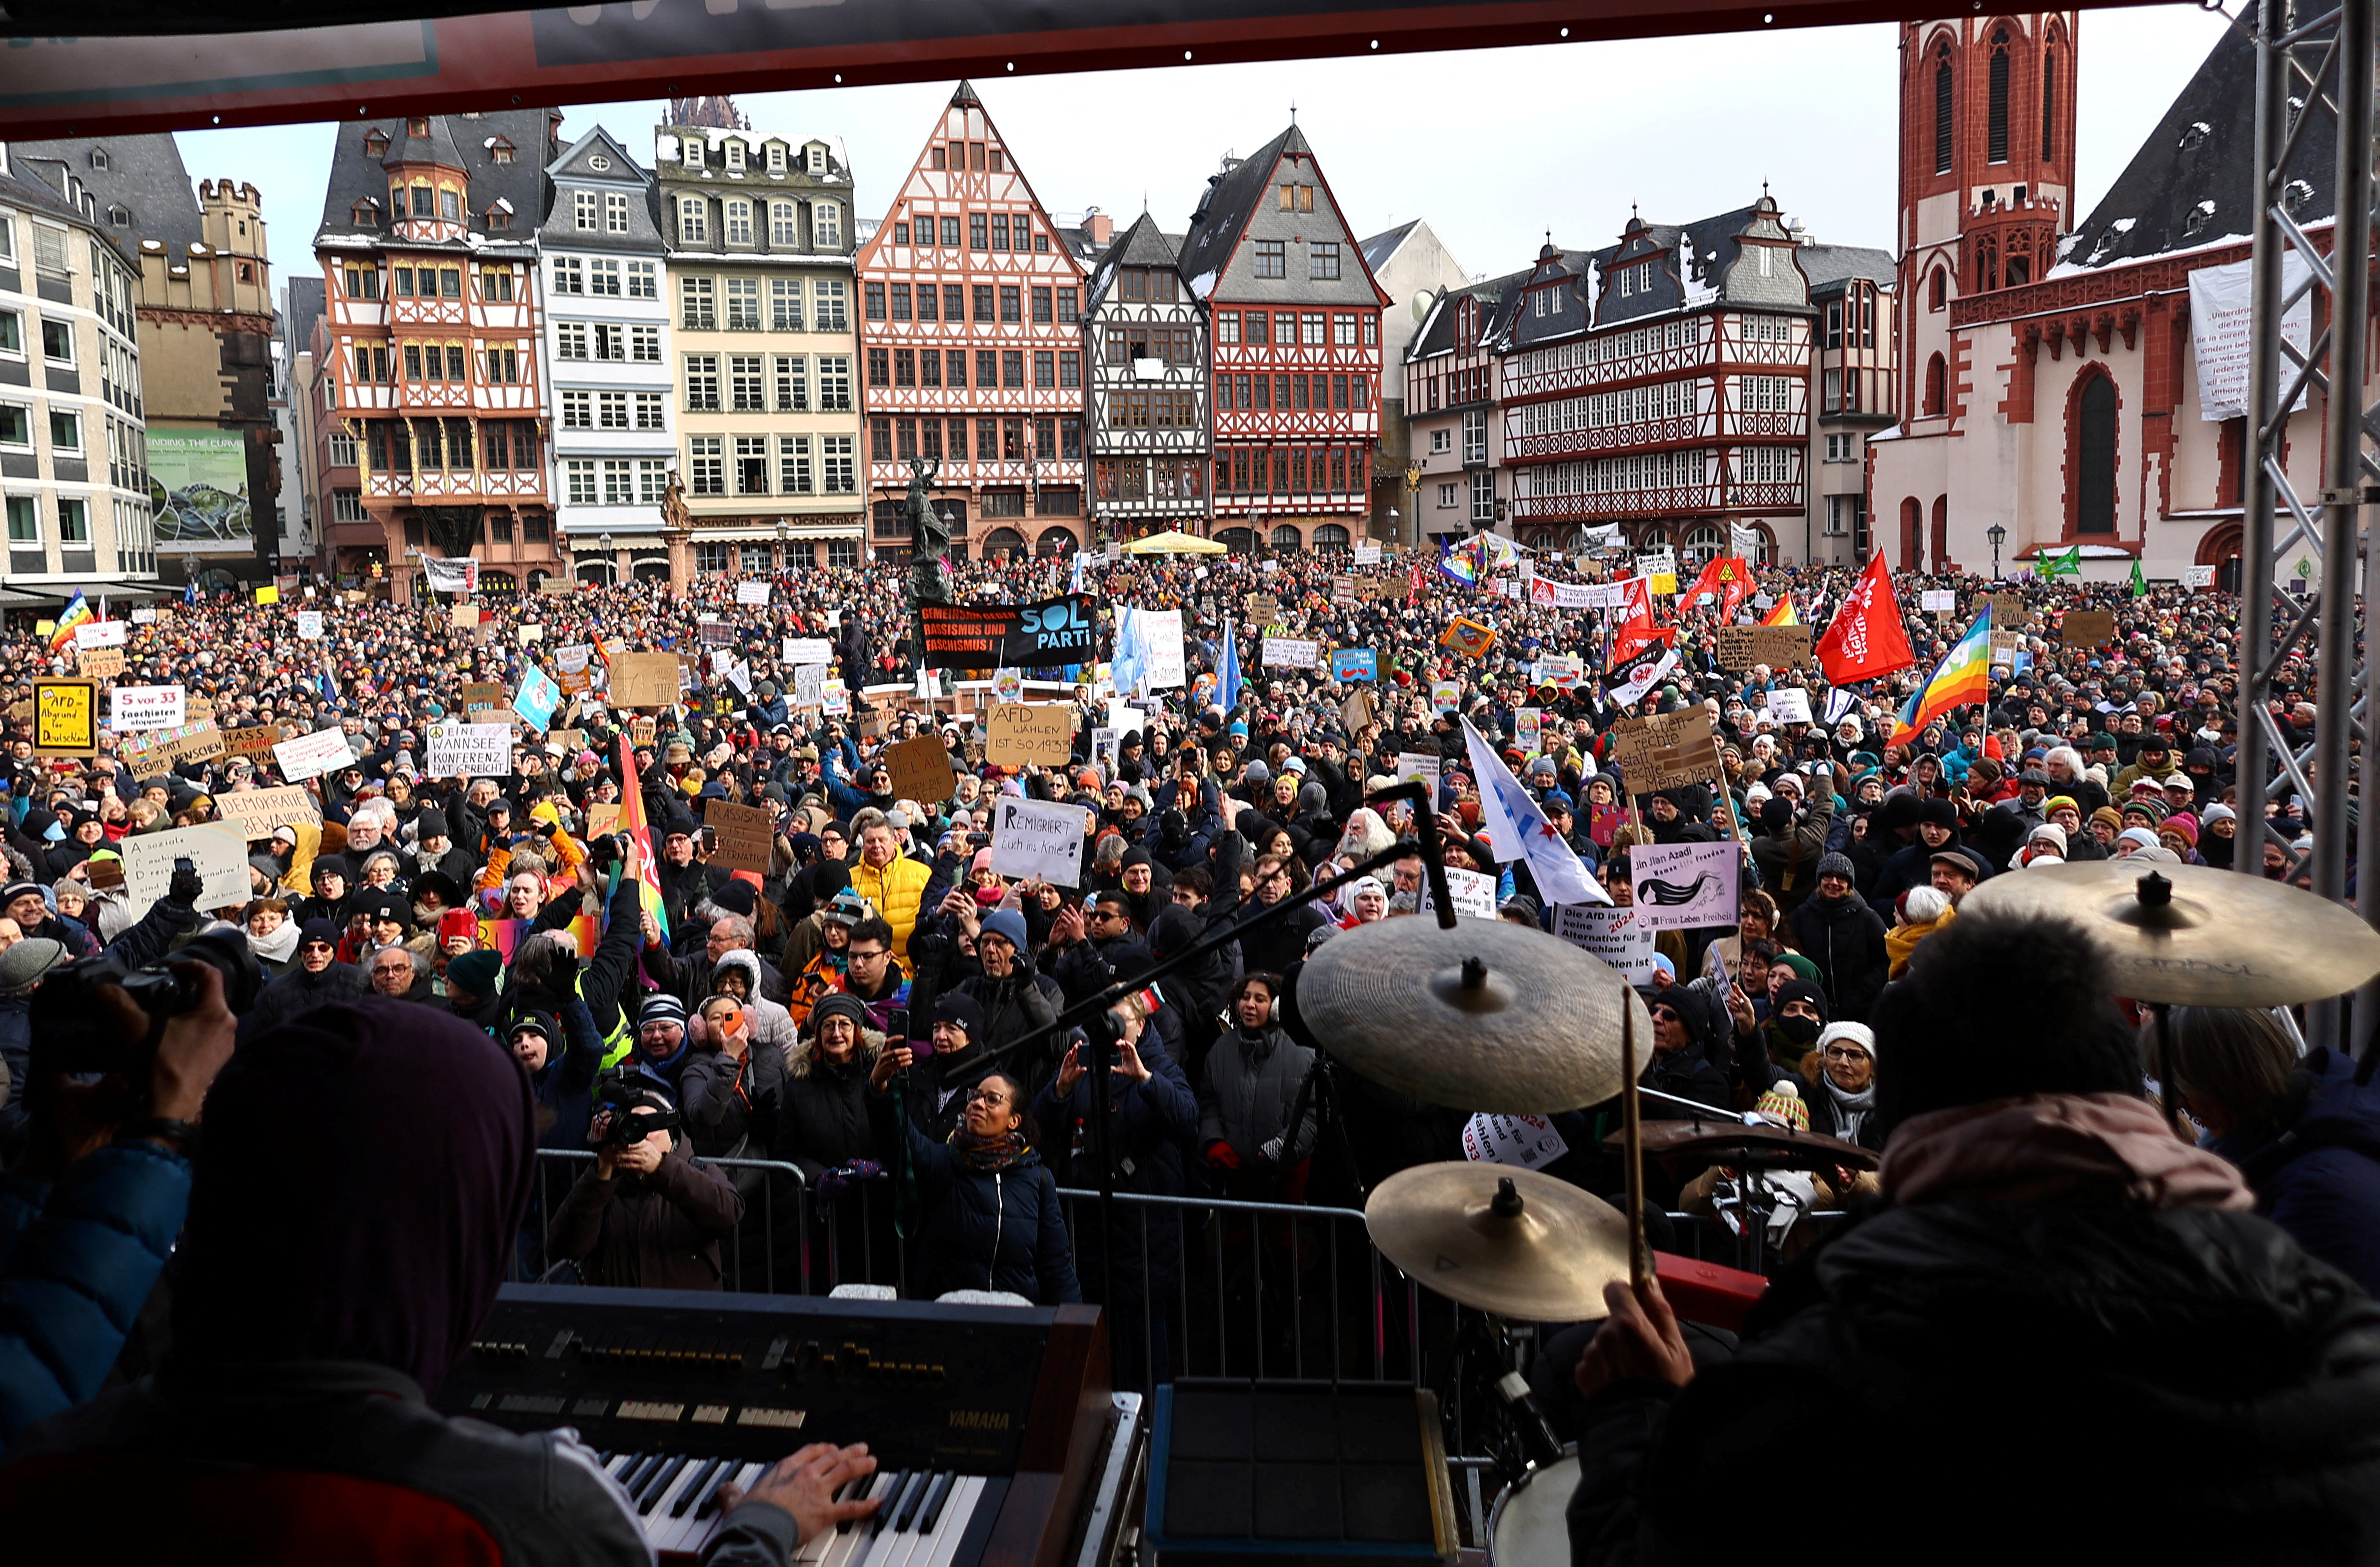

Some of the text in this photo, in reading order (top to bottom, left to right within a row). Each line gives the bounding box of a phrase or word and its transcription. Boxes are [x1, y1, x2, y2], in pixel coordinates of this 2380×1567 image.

[2209, 333, 2217, 342] in
[2219, 330, 2246, 340] eurem
[2200, 343, 2232, 354] sondern
[2197, 354, 2234, 367] genau wie
[2220, 375, 2244, 383] seinen
[692, 516, 858, 527] Souvenirs Geschenke
[922, 607, 982, 620] GEMEINSAM
[1021, 600, 1089, 634] SOL
[924, 623, 1006, 636] RASSISMUS UND
[1720, 629, 1735, 638] Aus
[926, 639, 987, 652] FASCHISMUS
[83, 653, 97, 662] Nie
[87, 662, 121, 675] 1933
[1614, 650, 1657, 681] EINTRACHT
[798, 666, 824, 683] SAGE
[122, 693, 133, 705] 5
[160, 692, 176, 703] 33
[41, 709, 77, 720] Abgrund
[994, 707, 1033, 723] AFD
[448, 727, 475, 736] EINE
[1013, 724, 1061, 734] WÄHLEN
[1097, 729, 1114, 740] BJÖRN
[1614, 716, 1695, 741] Menschen-
[43, 729, 89, 743] Deutschland
[121, 718, 217, 755] MENSCHENRECHTE
[1634, 732, 1680, 751] rechte
[156, 740, 182, 755] STATT
[241, 737, 273, 750] KEINE
[996, 739, 1070, 755] IST SO 1933
[131, 742, 222, 776] RECHTE MENSCHEN
[223, 750, 279, 765] MEINUN
[433, 752, 501, 764] KONFERENZ
[1622, 750, 1649, 767] statt
[433, 763, 503, 775] HAT GEREICHT
[887, 752, 946, 781] VIELFALT
[1625, 763, 1664, 780] rechte
[1645, 764, 1718, 792] Menschen
[897, 778, 941, 794] GEGEN DIE
[221, 791, 309, 815] DEMOKRATIE
[711, 803, 770, 825] RASSISMUS
[719, 835, 753, 850] KEINE
[1001, 834, 1023, 851] Euch
[1027, 839, 1036, 852] ins
[1041, 840, 1063, 856] Knie
[1636, 846, 1692, 871] Jin Jian Azadi
[1653, 865, 1677, 877] Woman
[1696, 848, 1726, 863] Freedom
[139, 882, 159, 894] sind
[1447, 871, 1479, 895] AfD ist 2024
[1473, 898, 1481, 907] für
[1563, 919, 1593, 931] keine
[1565, 909, 1582, 919] Die
[1585, 912, 1605, 920] AfD
[1608, 910, 1635, 934] 2024
[1660, 911, 1732, 925] Frau Leben Freiheit
[1561, 929, 1620, 943] Alternative
[1576, 944, 1626, 953] tschland
[1602, 957, 1649, 969] hlen ist
[1464, 1126, 1481, 1161] 1933
[1510, 1128, 1524, 1146] für
[949, 1410, 1009, 1430] YAMAHA
